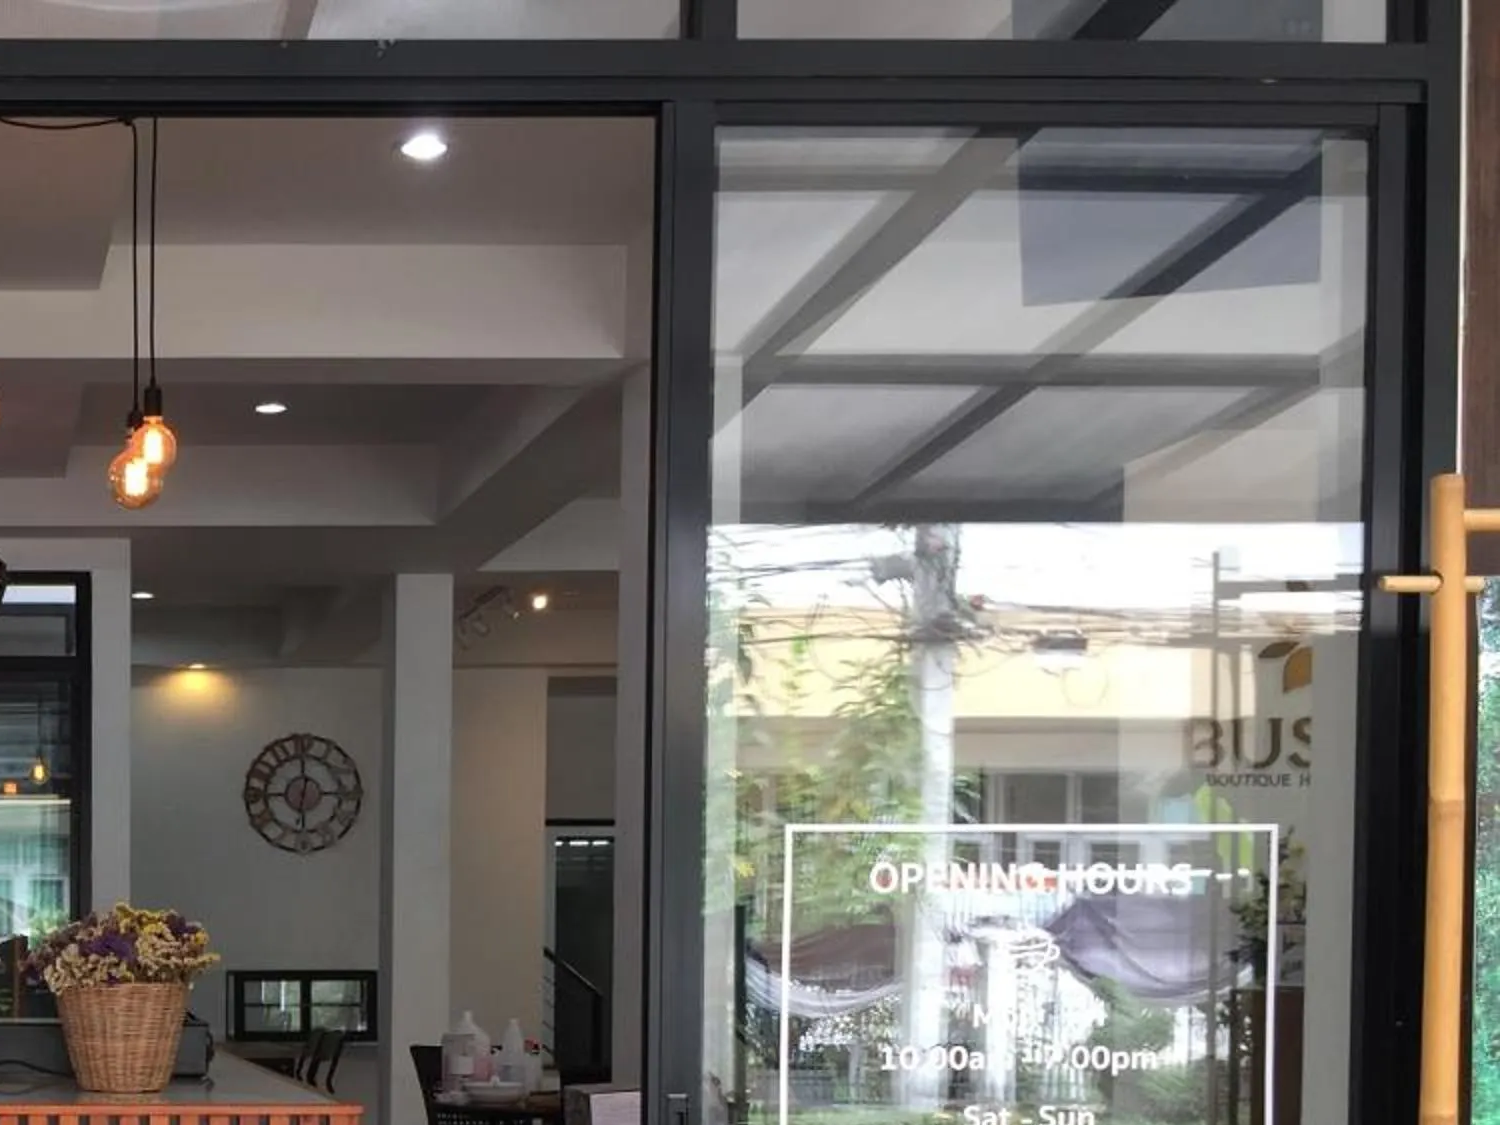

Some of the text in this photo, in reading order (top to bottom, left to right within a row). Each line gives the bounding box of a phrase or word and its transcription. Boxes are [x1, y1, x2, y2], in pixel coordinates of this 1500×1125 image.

[1206, 773, 1292, 787] BOUTIQUE
[869, 862, 1192, 895] OPENING HOURS
